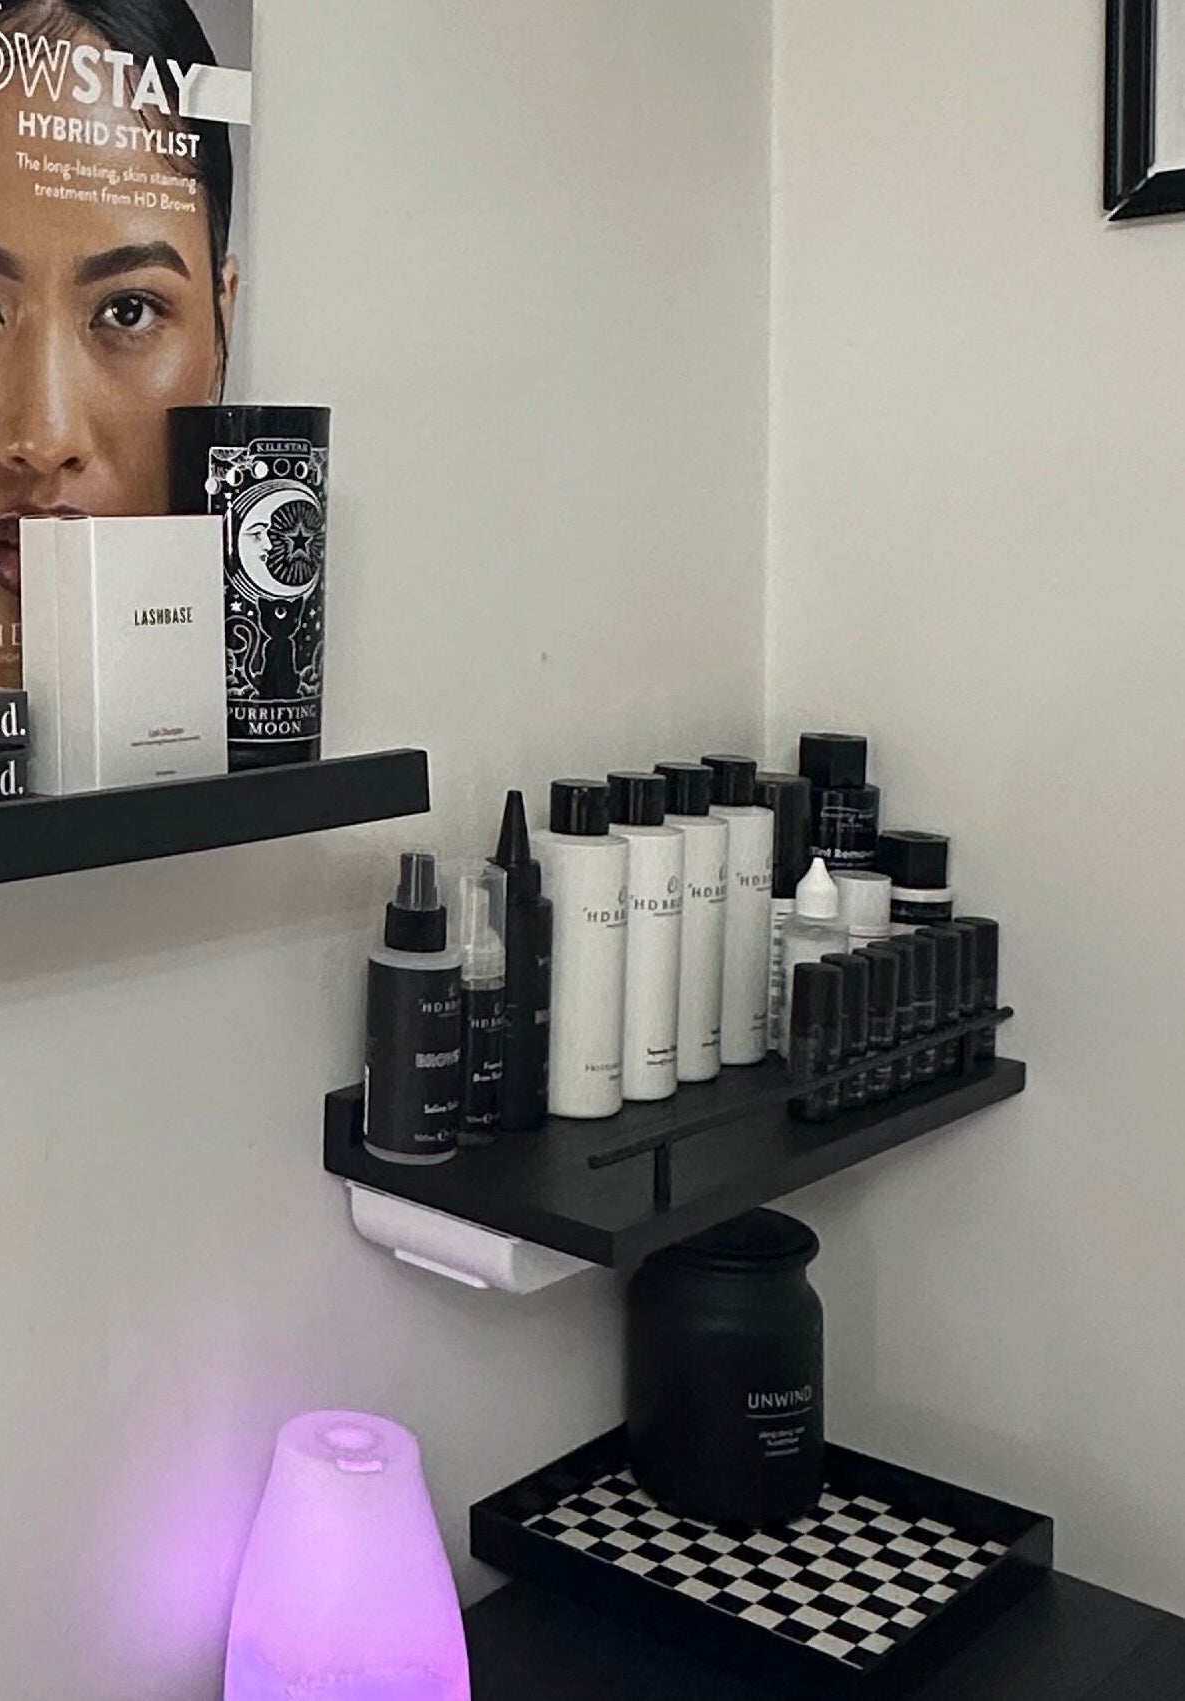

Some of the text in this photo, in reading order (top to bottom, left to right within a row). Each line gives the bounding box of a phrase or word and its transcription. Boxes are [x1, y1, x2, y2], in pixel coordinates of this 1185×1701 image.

[18, 110, 201, 158] HYBRID STYLIST
[16, 151, 40, 171] The
[43, 155, 120, 186] long-lasting,
[122, 167, 147, 183] skin
[34, 182, 98, 202] treatment
[101, 185, 132, 206] from
[134, 191, 157, 209] HD
[134, 606, 193, 626] LASHBASE
[249, 721, 302, 735] MOON
[834, 848, 875, 859] Remov
[748, 1385, 812, 1409] UNWIND
